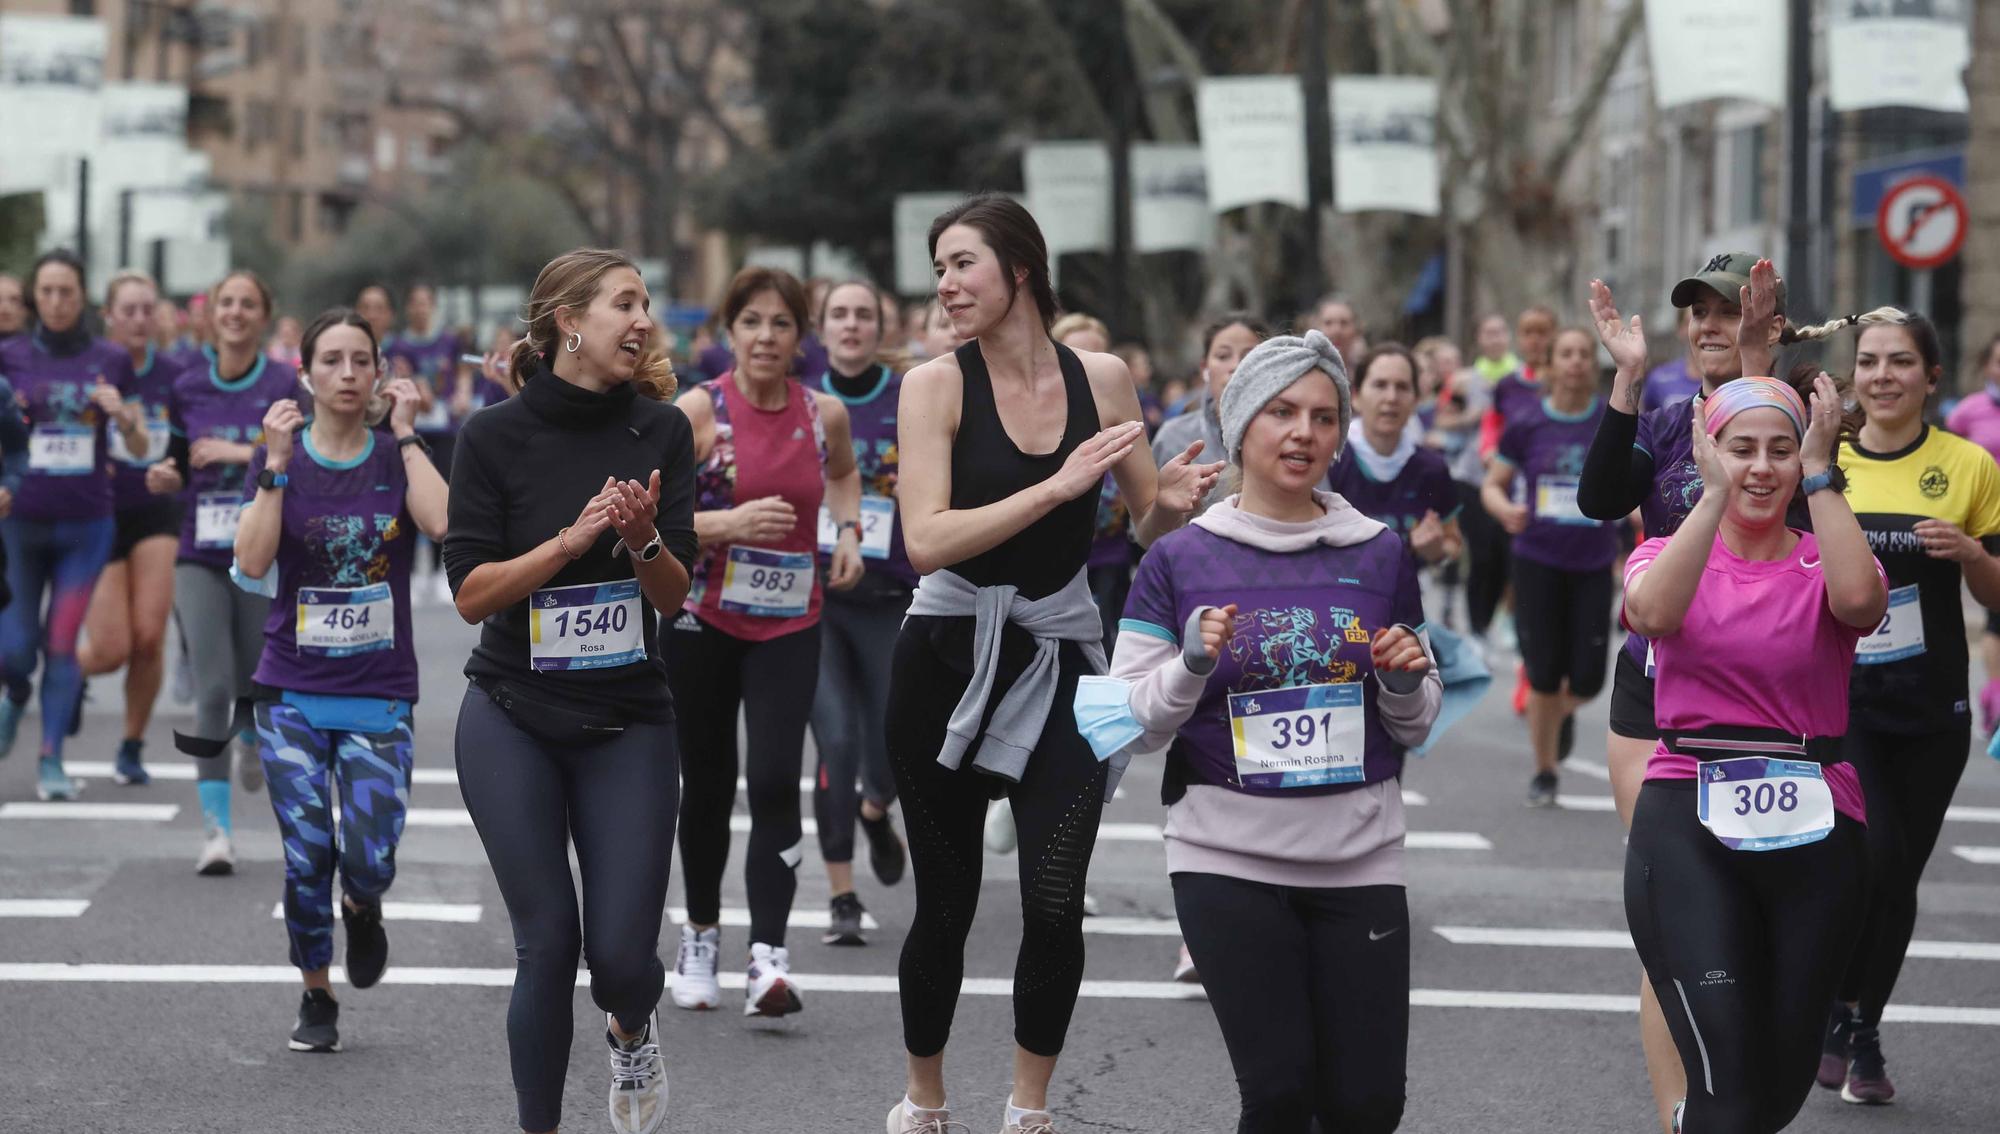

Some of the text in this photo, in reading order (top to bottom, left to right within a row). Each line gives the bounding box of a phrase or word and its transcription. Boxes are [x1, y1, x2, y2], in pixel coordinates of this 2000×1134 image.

[750, 569, 796, 592] 983
[324, 607, 370, 630] 464
[555, 604, 627, 637] 1540
[580, 643, 605, 652] Rosa
[1347, 631, 1367, 641] FEM
[1271, 712, 1331, 749] 391
[1734, 781, 1798, 816] 308
